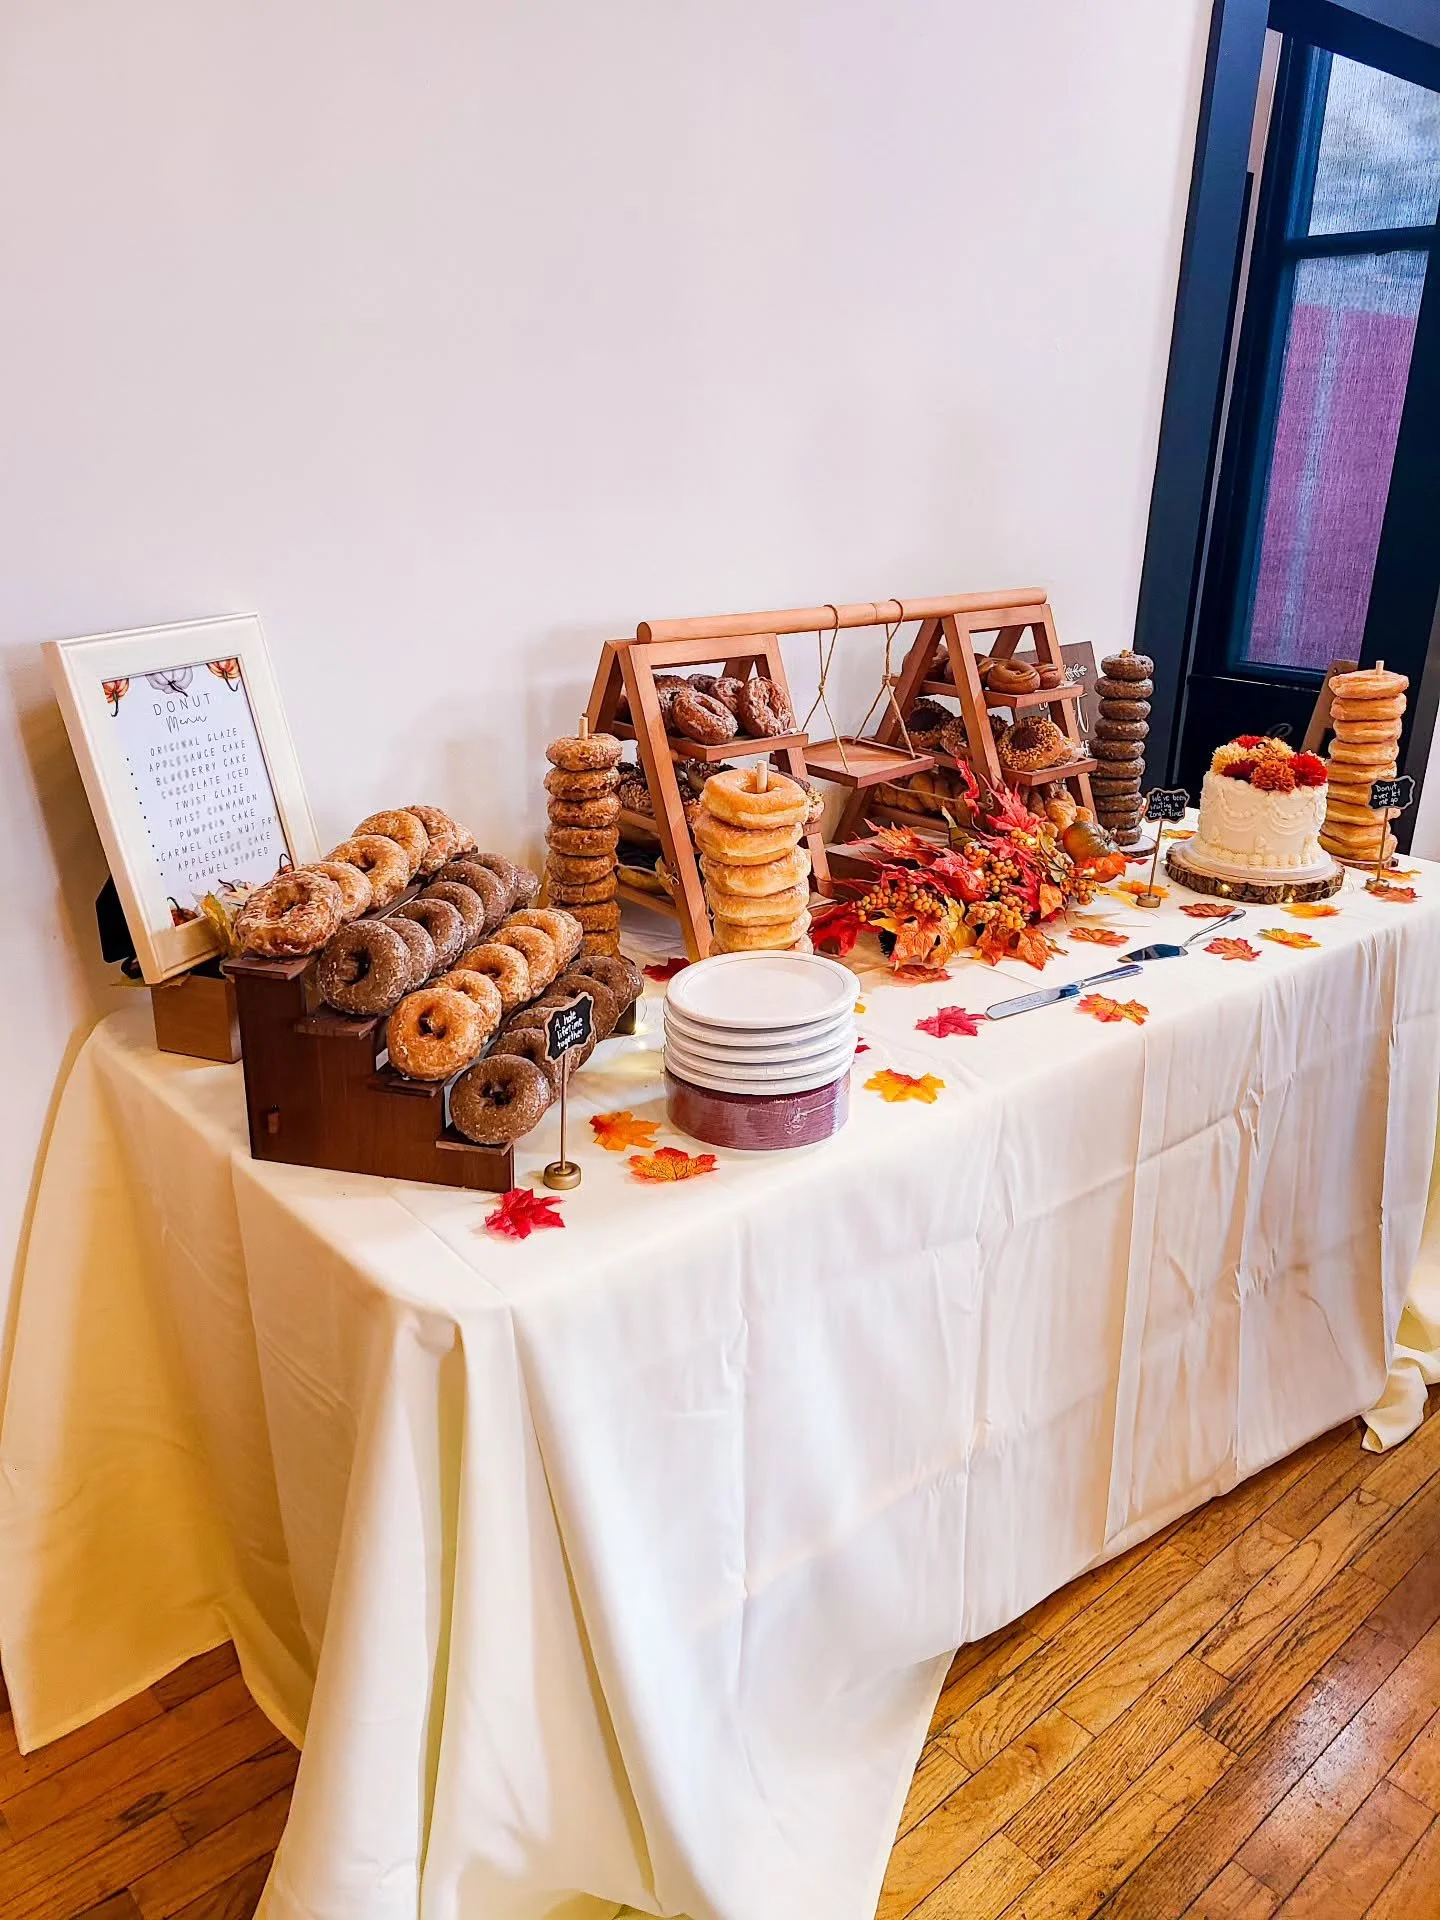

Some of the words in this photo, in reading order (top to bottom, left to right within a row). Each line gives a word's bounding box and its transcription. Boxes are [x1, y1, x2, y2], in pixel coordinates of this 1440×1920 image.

[153, 693, 210, 716] DONUT
[165, 715, 208, 733] Menu
[207, 727, 237, 742] GLAZE
[222, 739, 246, 753] CAKE
[223, 753, 247, 767] CAKE
[227, 767, 249, 780] ICED
[1375, 781, 1397, 792] Donut
[175, 794, 206, 811] TWIST
[214, 783, 244, 799] GLAZE
[232, 808, 256, 822] CAKE
[161, 841, 202, 862] CARMEL
[238, 822, 255, 834] NUT
[248, 831, 271, 846] CAKE
[188, 863, 228, 882] CARMEL
[555, 1017, 561, 1032] A
[557, 1017, 583, 1040] lifetime
[557, 1028, 584, 1050] together
